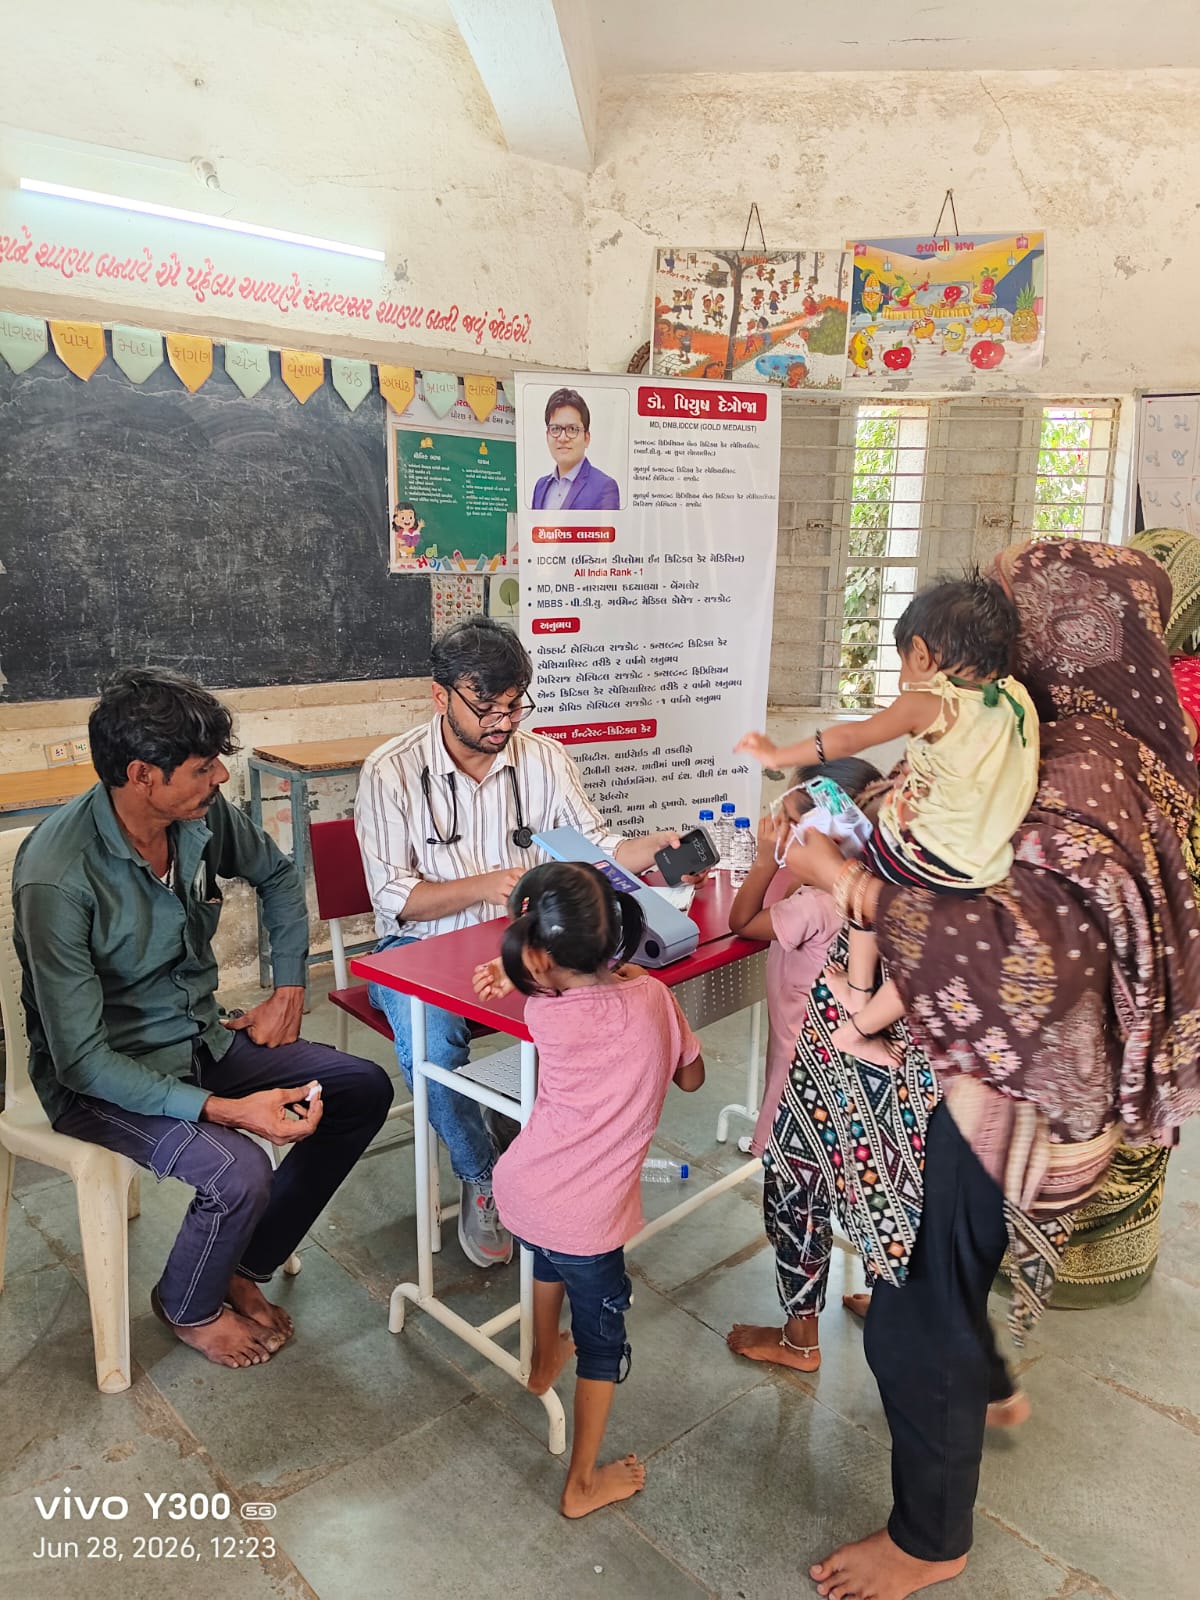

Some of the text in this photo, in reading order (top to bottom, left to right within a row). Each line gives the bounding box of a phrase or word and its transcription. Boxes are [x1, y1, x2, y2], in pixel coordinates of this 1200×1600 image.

[96, 248, 152, 282] બનાવે
[376, 302, 424, 330] શાણા
[426, 304, 459, 332] બની
[462, 311, 488, 344] જવું
[674, 394, 710, 416] પિયુષ
[718, 395, 757, 414] દેત્રોજા
[650, 421, 661, 430] MD,
[700, 422, 720, 432] (GOLD
[722, 424, 757, 432] MEDALIST)
[576, 531, 610, 539] લાયકાત
[537, 556, 566, 564] IDCCM
[588, 568, 608, 577] India
[610, 568, 632, 576] Rank
[537, 584, 553, 594] MD,
[556, 584, 574, 592] DNB
[537, 600, 563, 608] MBBS
[540, 622, 572, 632] અનુભવ
[570, 644, 605, 654] હોસ્પિટલ
[610, 642, 639, 652] રાજકોટ
[592, 657, 611, 667] તરીકે
[650, 656, 678, 666] અનુભવ
[576, 672, 610, 682] હોસ્પિટલ
[615, 670, 643, 680] રાજકોટ
[660, 682, 678, 691] તરીકે
[715, 680, 742, 689] અનુભવ
[586, 700, 620, 711] હોસ્પિટલ
[625, 698, 652, 708] રાજકોટ
[696, 694, 722, 704] અનુભવ
[574, 752, 610, 762] યાબિટીસ,
[652, 747, 661, 756] ની
[672, 758, 690, 768] પાણી
[648, 800, 658, 808] નો
